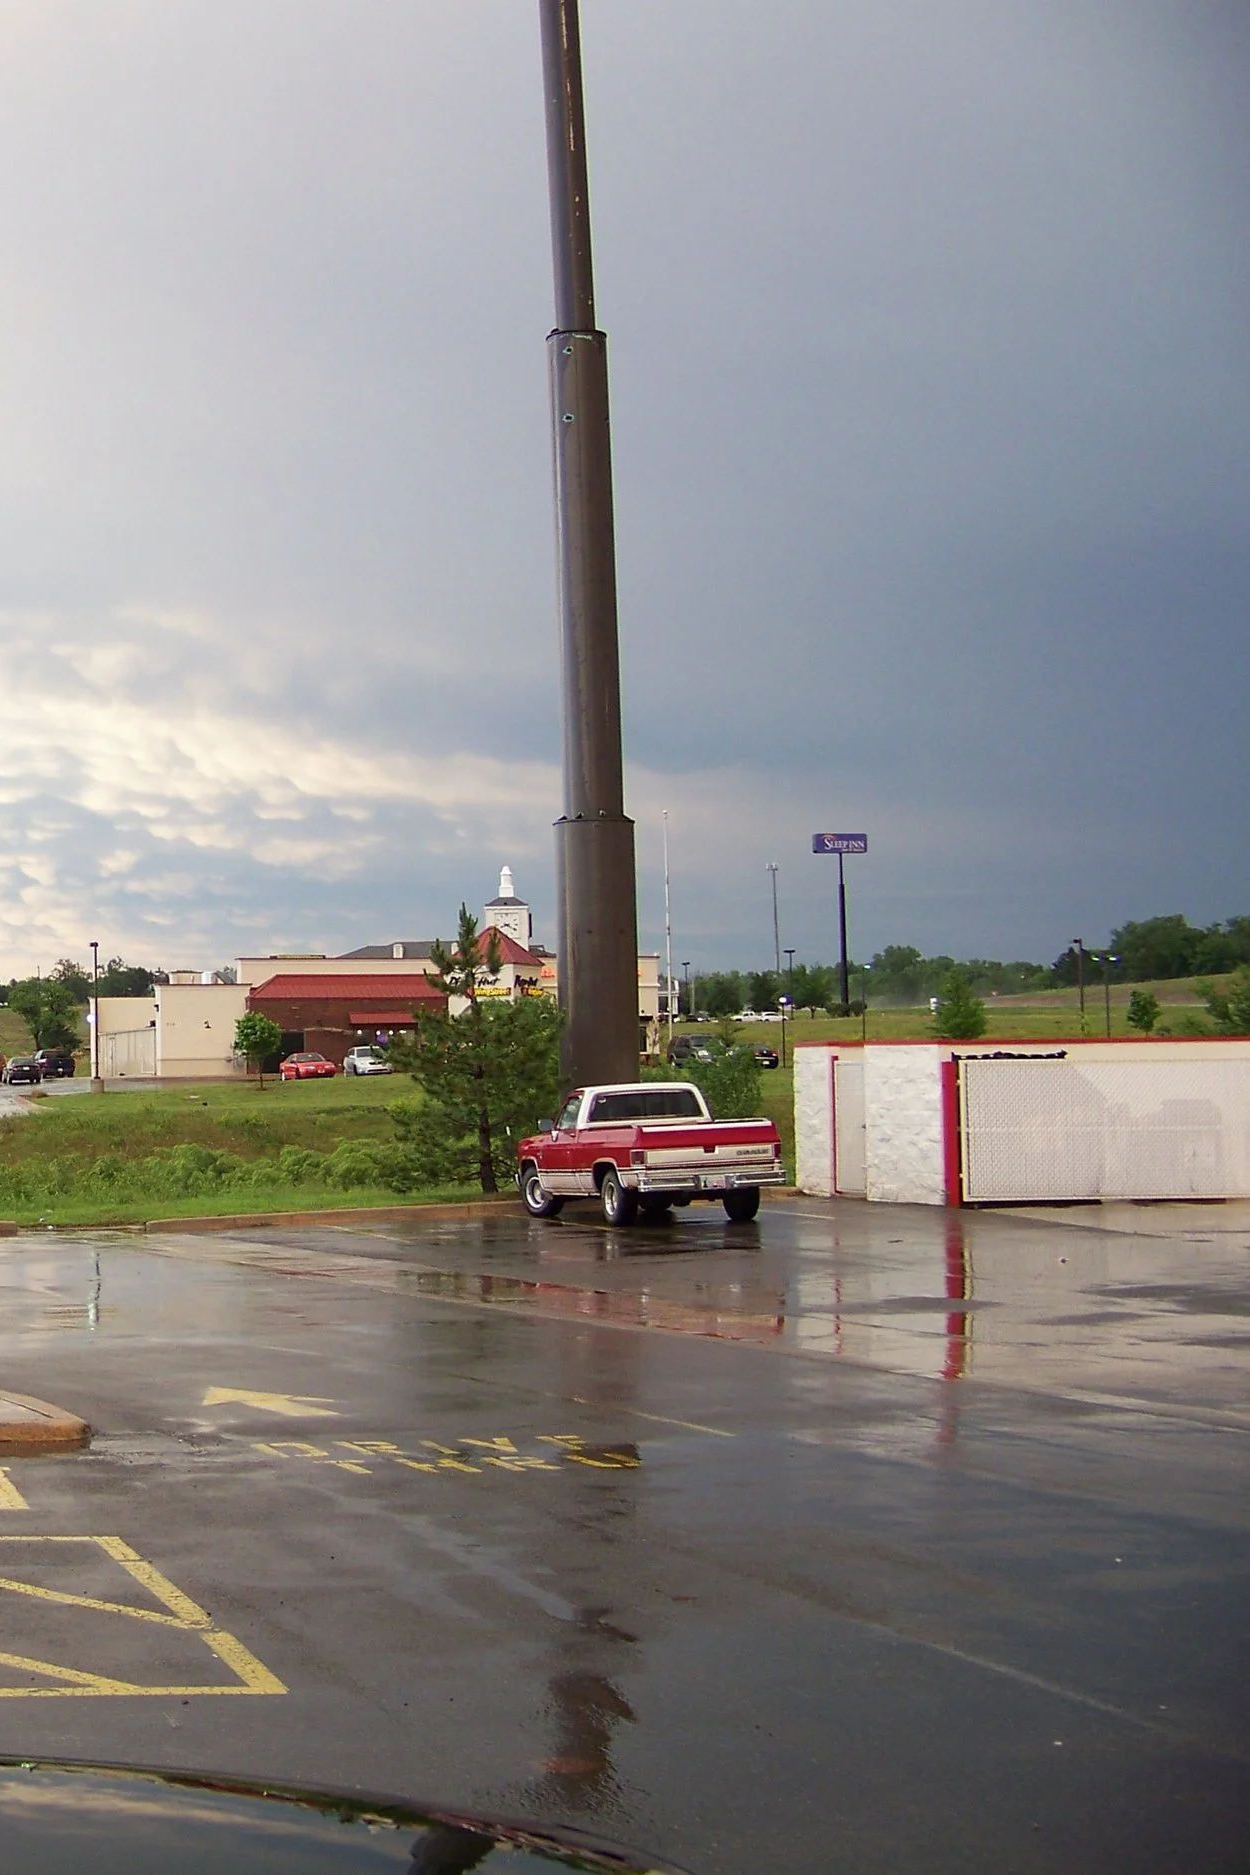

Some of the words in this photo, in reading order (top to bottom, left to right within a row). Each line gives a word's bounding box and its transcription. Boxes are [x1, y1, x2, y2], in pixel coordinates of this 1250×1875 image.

[849, 840, 865, 849] INN
[251, 1435, 588, 1458] DRIVE
[312, 1452, 640, 1474] THRU
